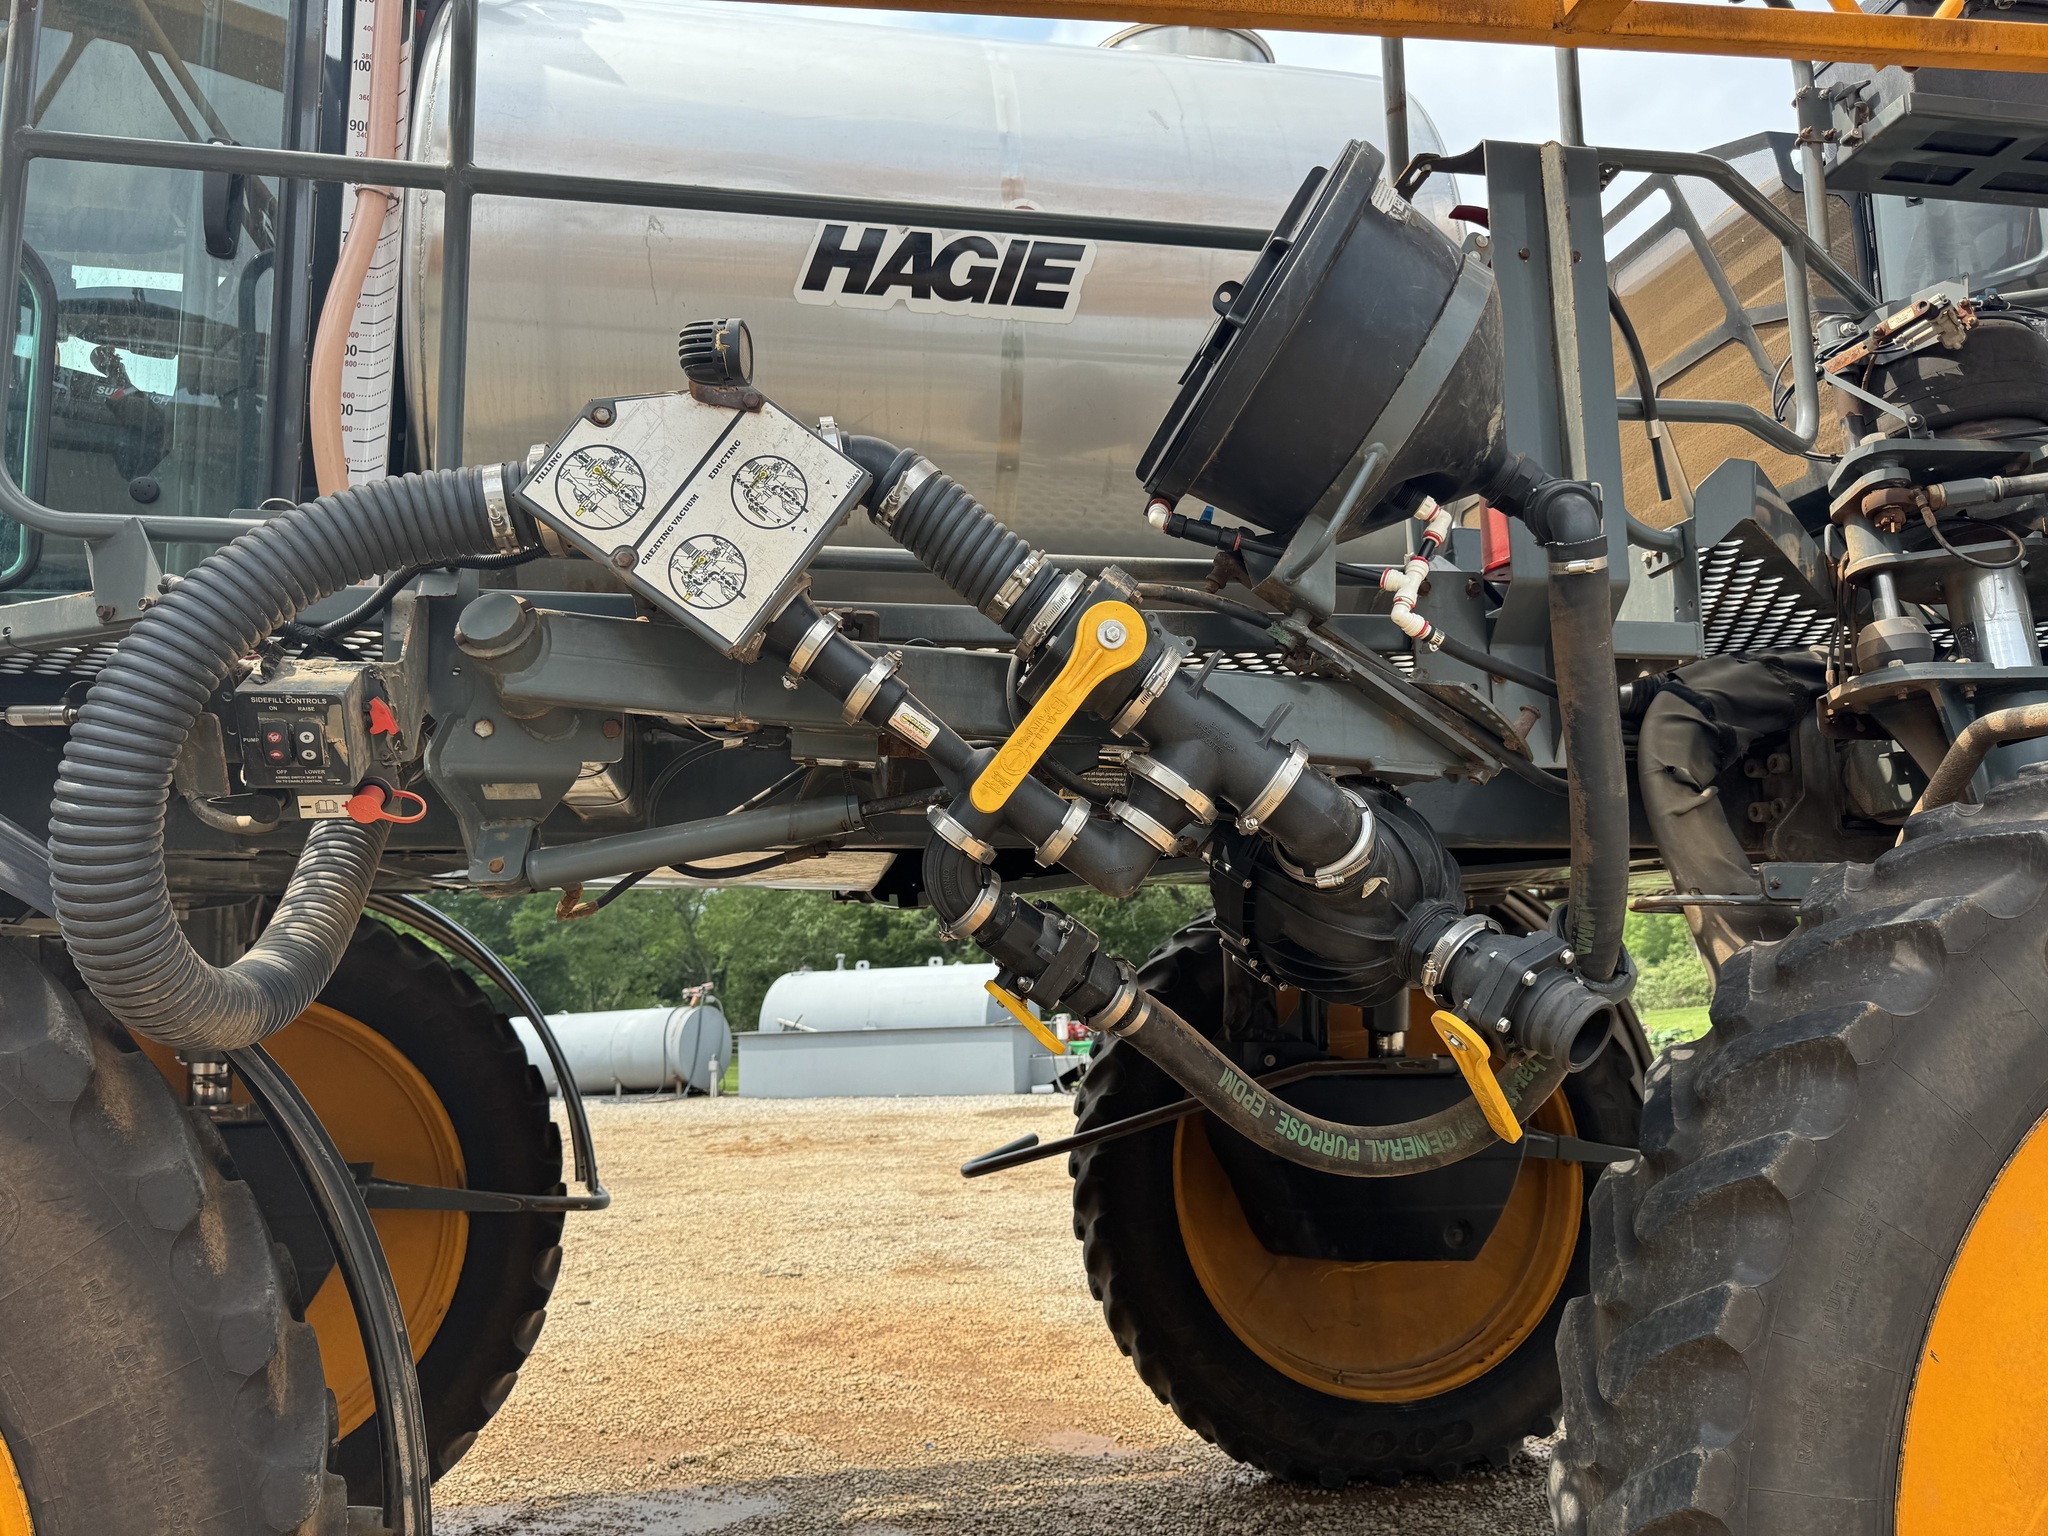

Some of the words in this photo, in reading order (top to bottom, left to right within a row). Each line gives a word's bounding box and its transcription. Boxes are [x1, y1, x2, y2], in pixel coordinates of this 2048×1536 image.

[802, 224, 1086, 309] HAGIE
[535, 452, 563, 485] FILLING
[708, 440, 741, 480] EDUCTING
[641, 525, 674, 565] CREATING
[671, 494, 699, 526] VACUUM
[250, 696, 284, 704] SIDEFILL
[1217, 1066, 1267, 1119] EPDM
[1274, 1110, 1360, 1161] PURPOSE
[1364, 1126, 1458, 1163] GENERAL
[80, 1278, 142, 1382] RADIAL
[1795, 1363, 1828, 1466] RADIAL
[1821, 1198, 1879, 1333] TUBELESS
